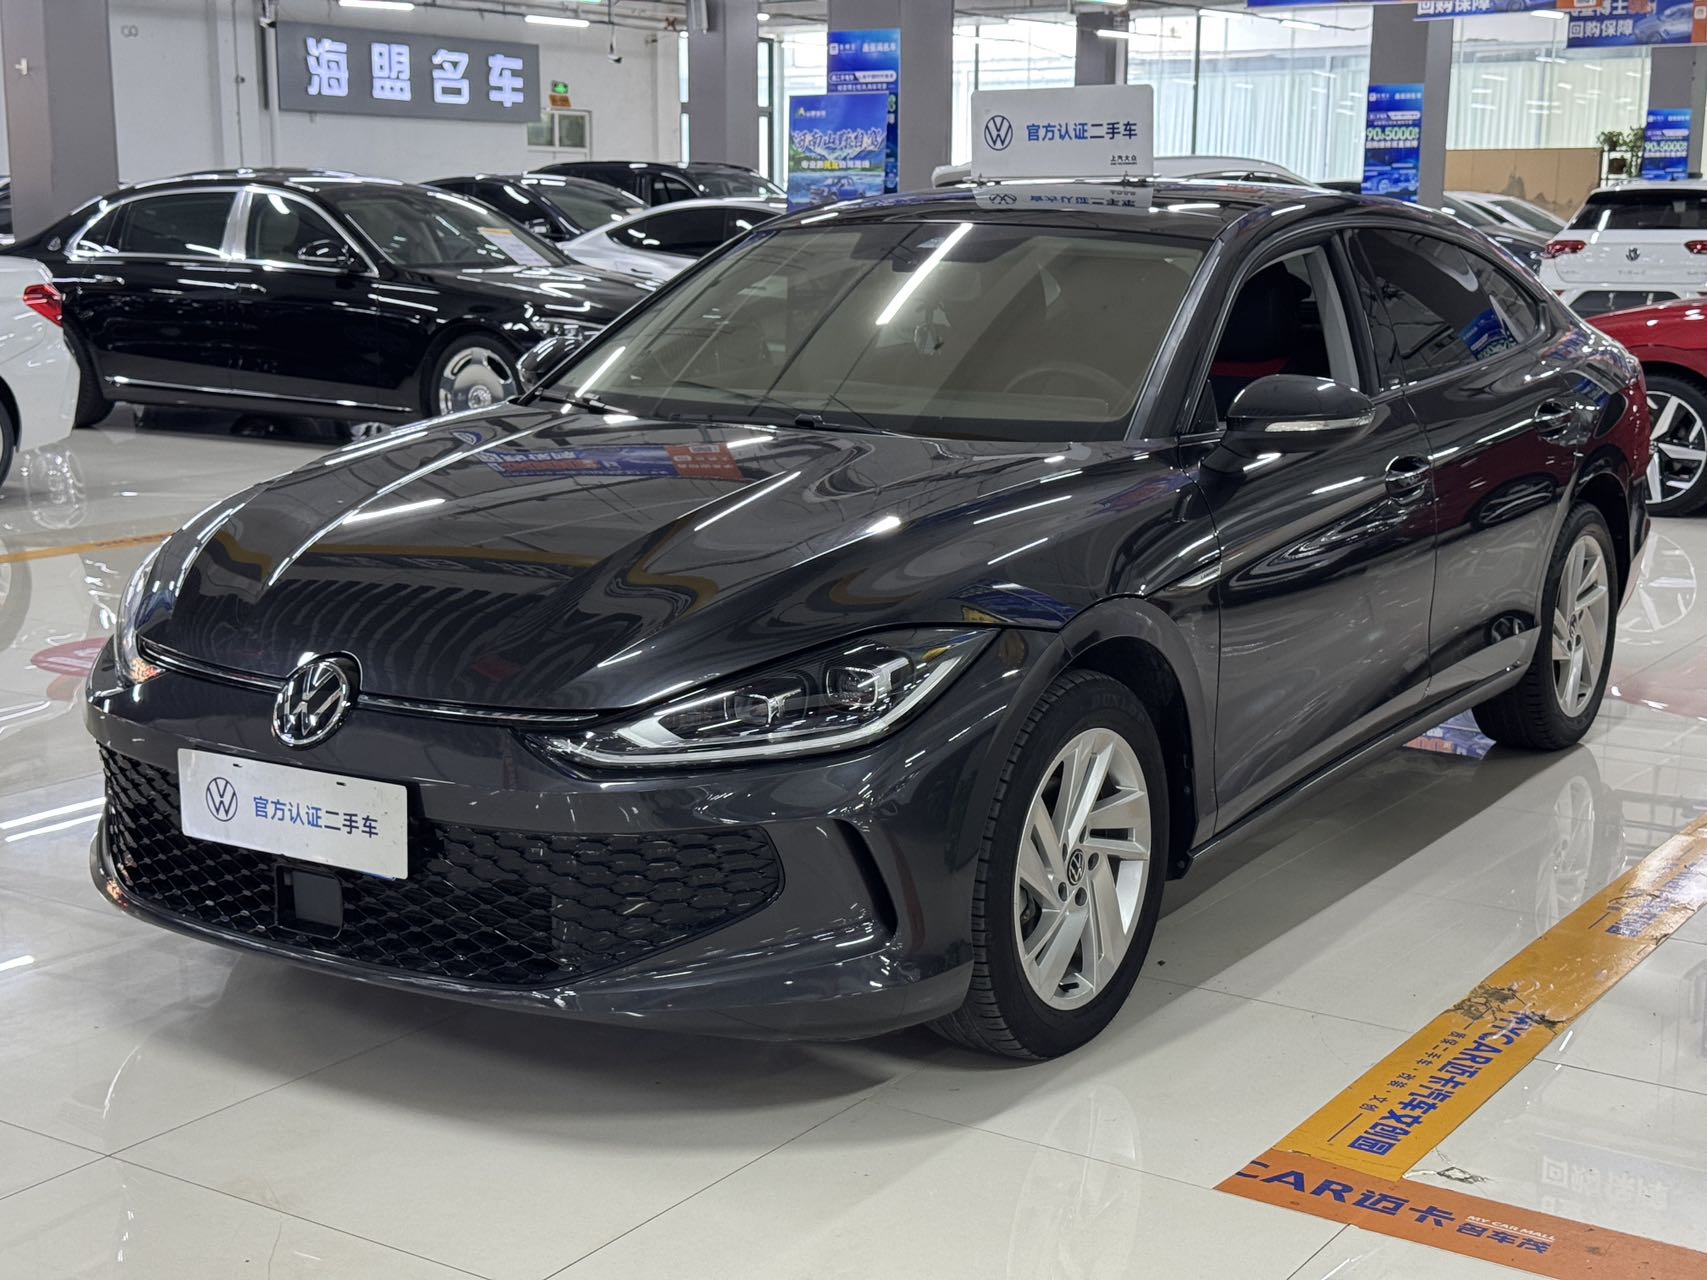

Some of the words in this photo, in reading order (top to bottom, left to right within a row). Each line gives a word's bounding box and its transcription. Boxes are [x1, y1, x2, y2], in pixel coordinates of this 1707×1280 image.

[1569, 19, 1634, 38] 回购保障
[305, 37, 525, 107] 海盟名车
[1026, 121, 1138, 142] 官方认证二手车
[253, 795, 379, 839] 官方认证二手车
[1456, 1222, 1551, 1254] 名车茂
[1467, 1215, 1490, 1224] MY
[1492, 1221, 1518, 1232] CAR
[1520, 1228, 1556, 1241] MALL
